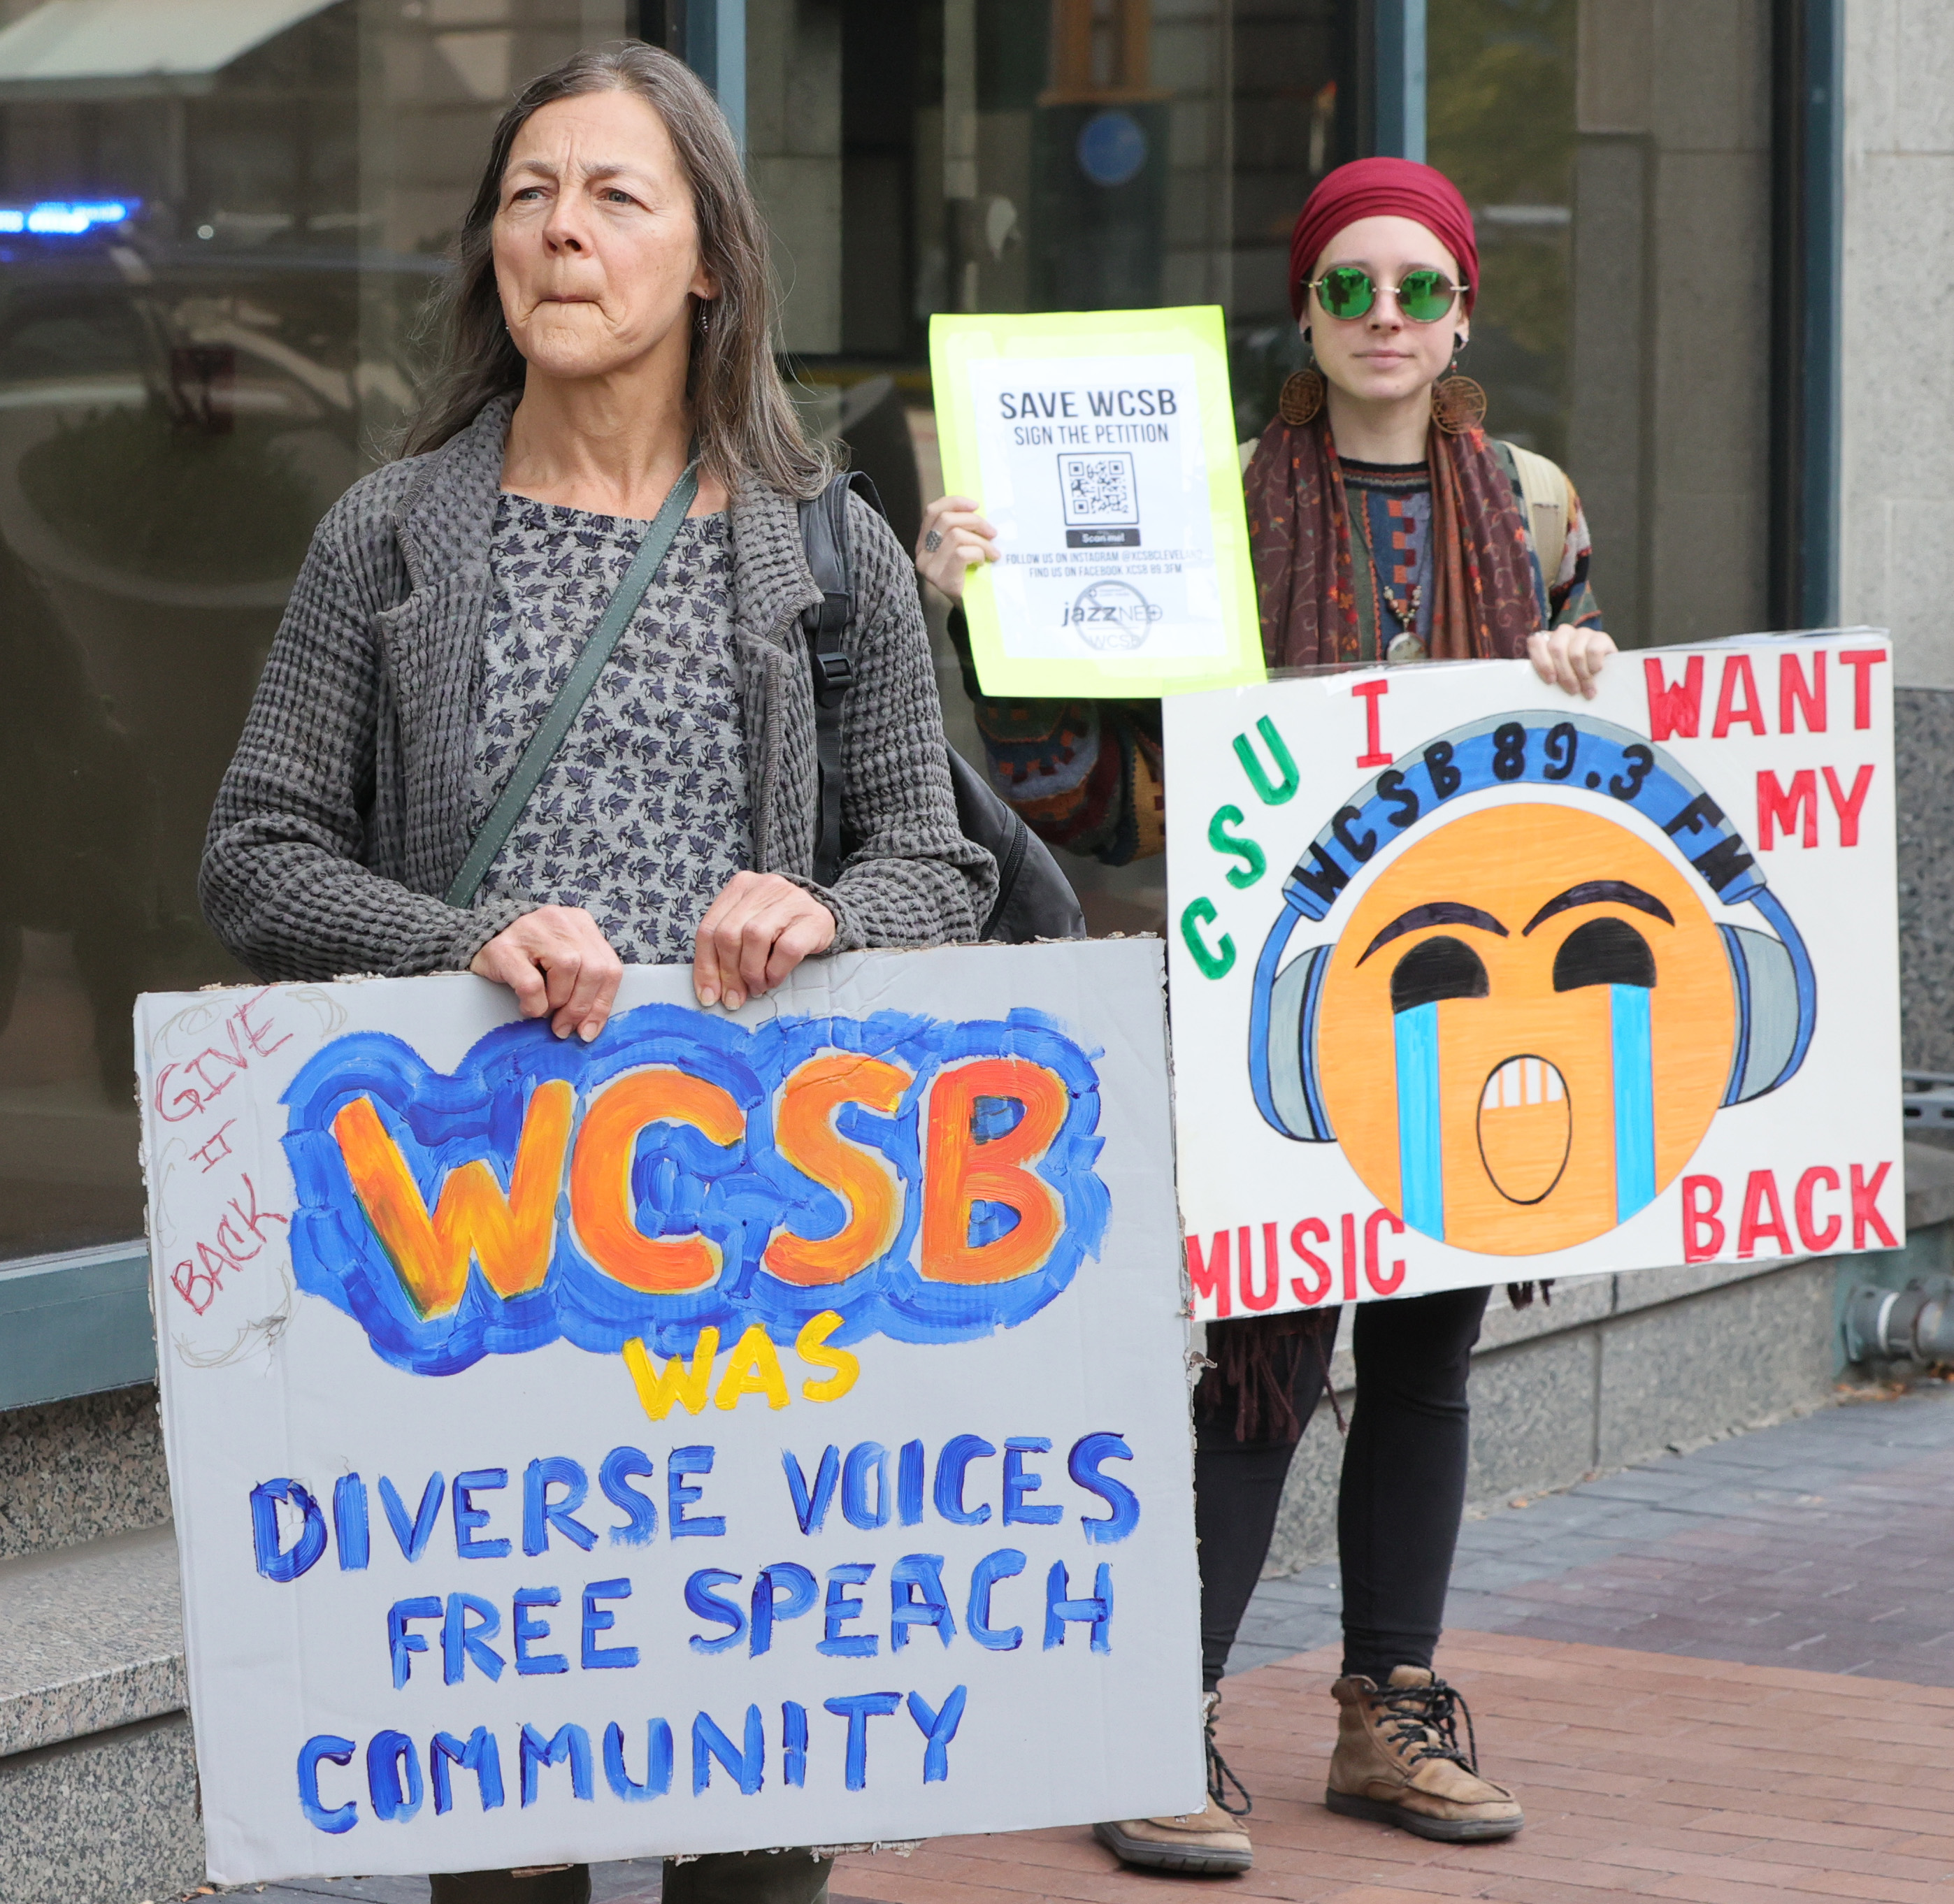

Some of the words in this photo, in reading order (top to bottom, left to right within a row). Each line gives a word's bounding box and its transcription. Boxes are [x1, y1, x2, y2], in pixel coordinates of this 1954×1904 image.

[1000, 390, 1079, 419] SAVE
[1089, 389, 1177, 418] WCSB
[1014, 426, 1053, 446] SIGN
[1061, 425, 1091, 445] THE
[1096, 423, 1169, 444] PETITION
[1005, 554, 1040, 564] FOLLOW
[1042, 553, 1054, 563] US
[1056, 552, 1068, 563] ON
[1070, 551, 1119, 562] INSTAGRAM
[1029, 568, 1049, 578] FIND
[1051, 567, 1063, 577] US
[1065, 566, 1076, 577] ON
[1079, 565, 1123, 576] FACEBOOK
[1082, 533, 1106, 543] Scan
[1351, 679, 1393, 768] I
[1643, 649, 1887, 743] WANT
[1290, 740, 1461, 904] WCSB
[1491, 721, 1655, 800] 89.3
[1662, 791, 1758, 893] FM
[1756, 764, 1875, 851] MY
[155, 983, 294, 1123] GIVE
[189, 1118, 237, 1174] IT
[331, 1054, 1069, 1322] WCSB
[170, 1171, 288, 1316] BACK
[1185, 1208, 1406, 1320] MUSIC
[1681, 1162, 1899, 1265] BACK
[620, 1309, 861, 1422] WAS
[250, 1444, 727, 1583] DIVERSE
[780, 1431, 1142, 1546] VOICES
[387, 1577, 641, 1690] FREE
[684, 1548, 1113, 1660] SPEACH
[296, 1683, 968, 1836] COMMUNITY
